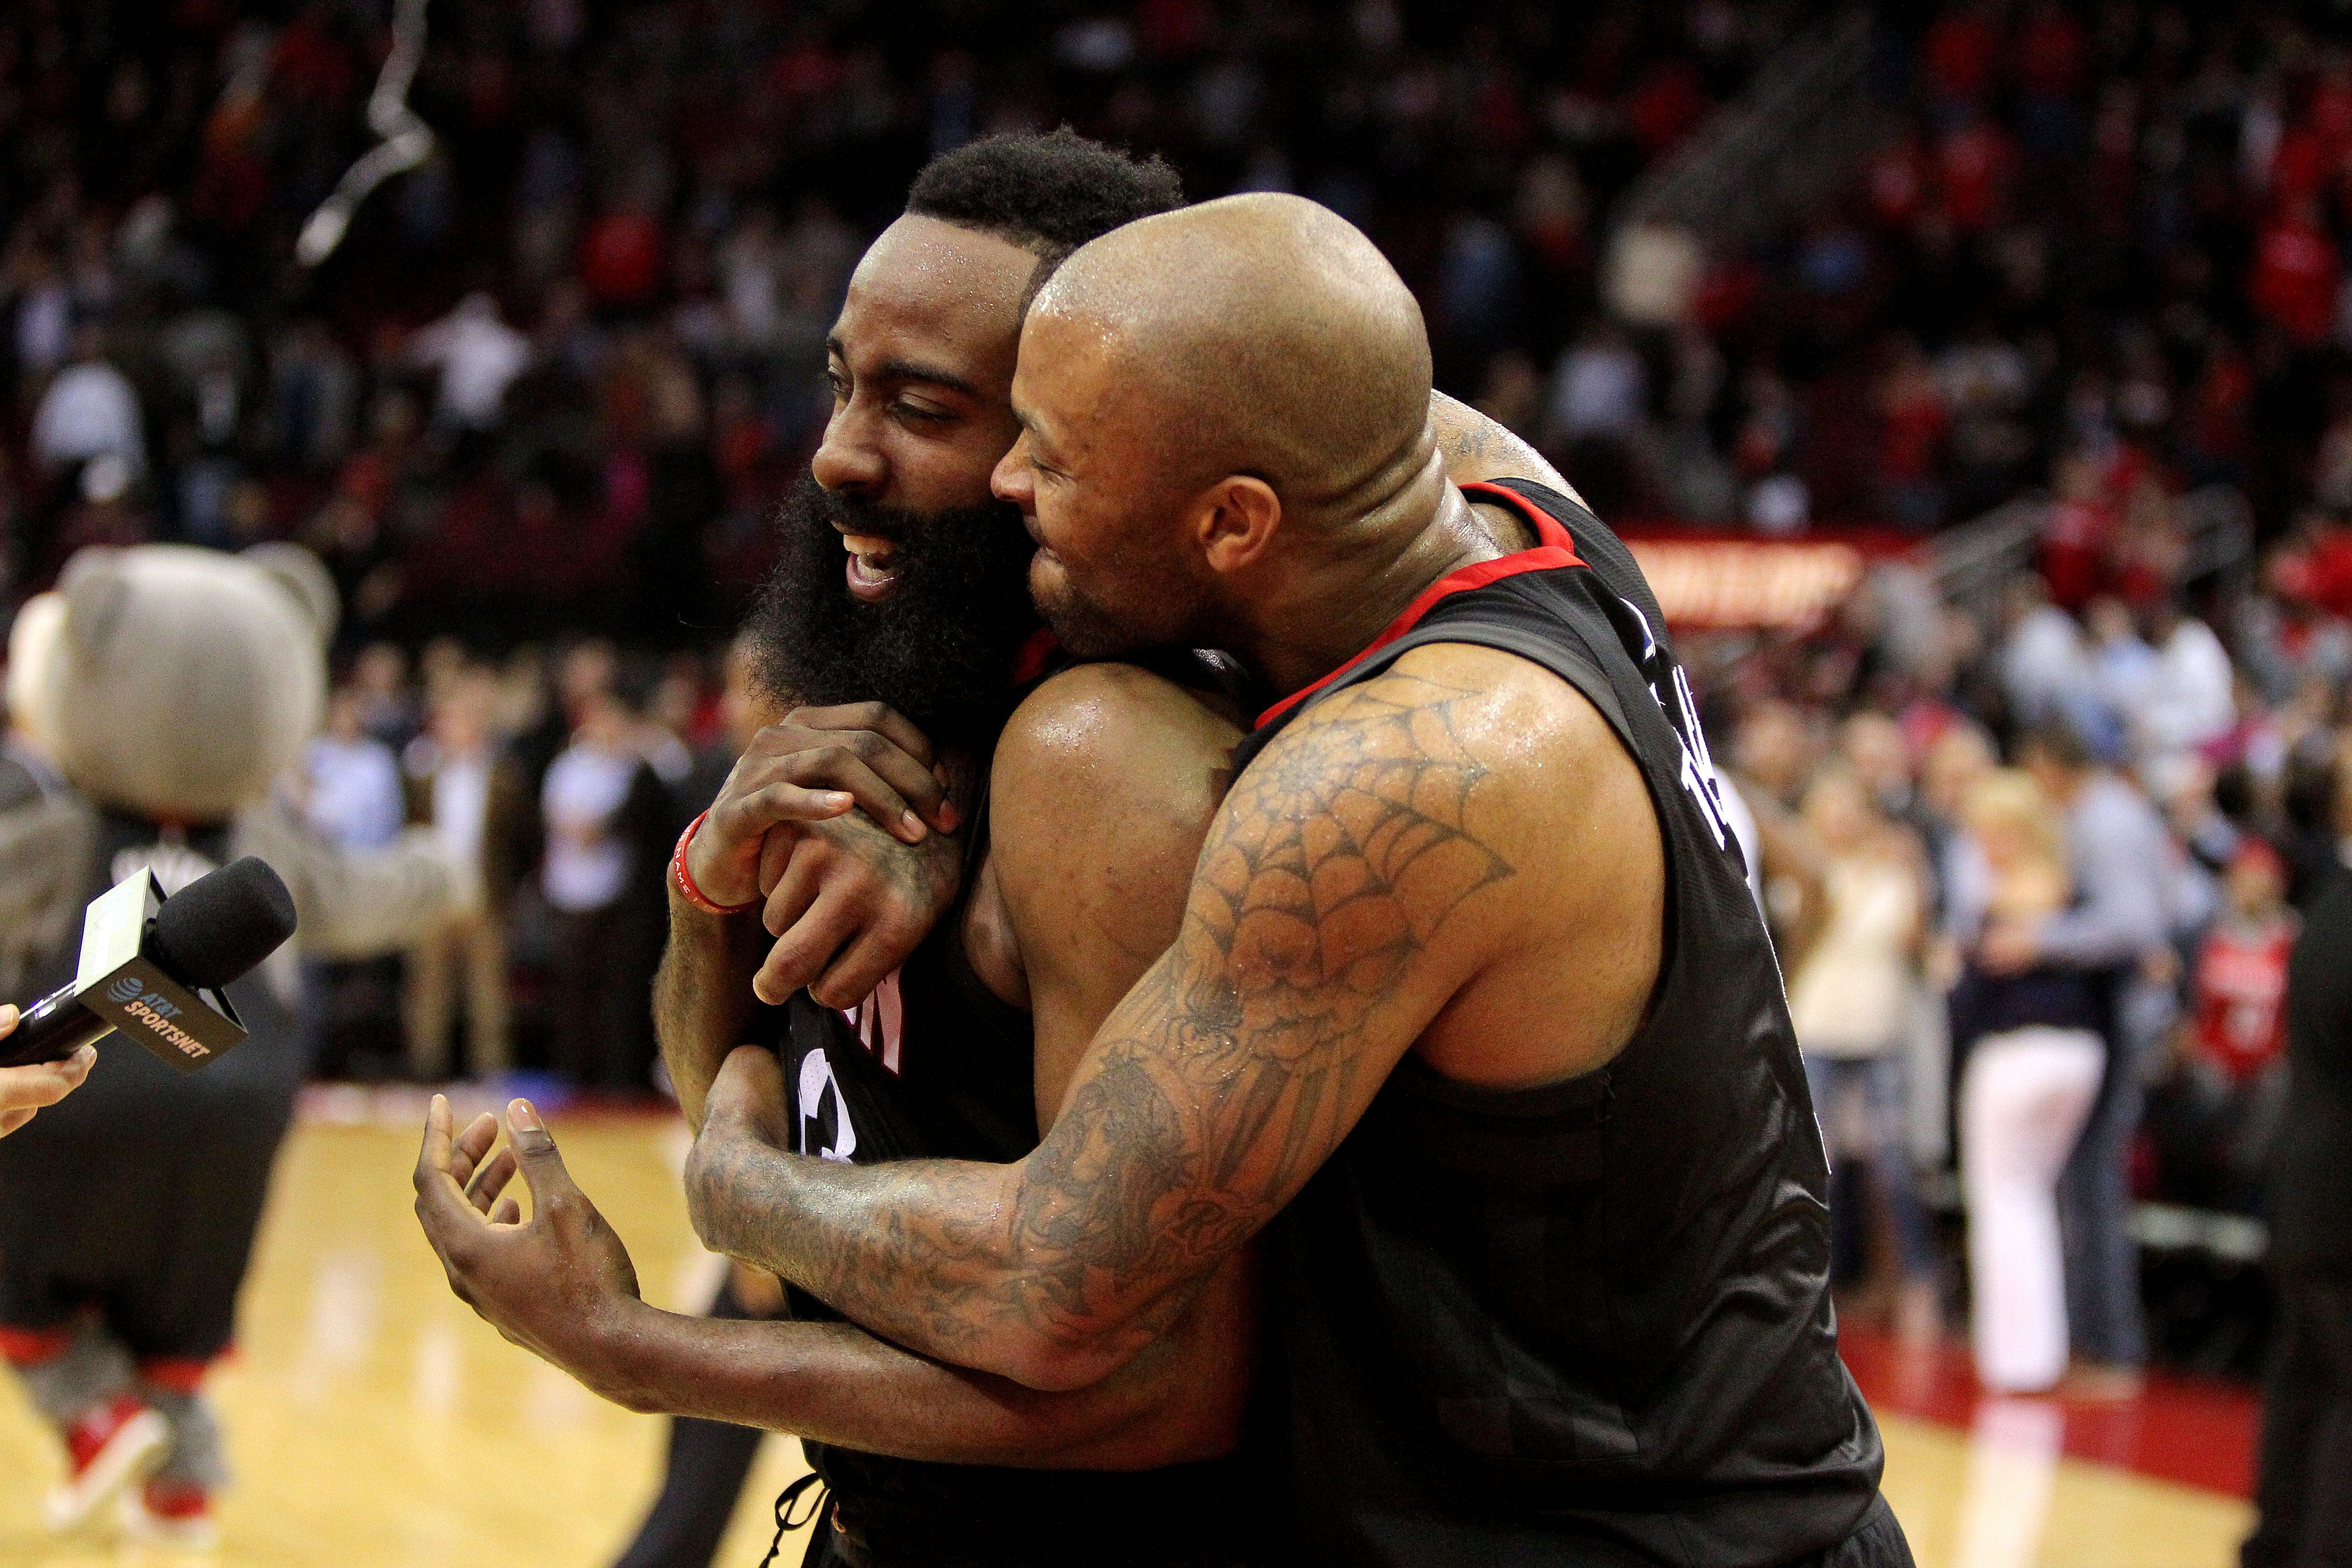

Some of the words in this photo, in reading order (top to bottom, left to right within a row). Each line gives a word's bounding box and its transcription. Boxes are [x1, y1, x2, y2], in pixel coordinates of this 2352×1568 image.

[675, 846, 690, 894] NAME
[124, 1001, 211, 1058] SPORTSNET
[138, 993, 184, 1018] AT&T
